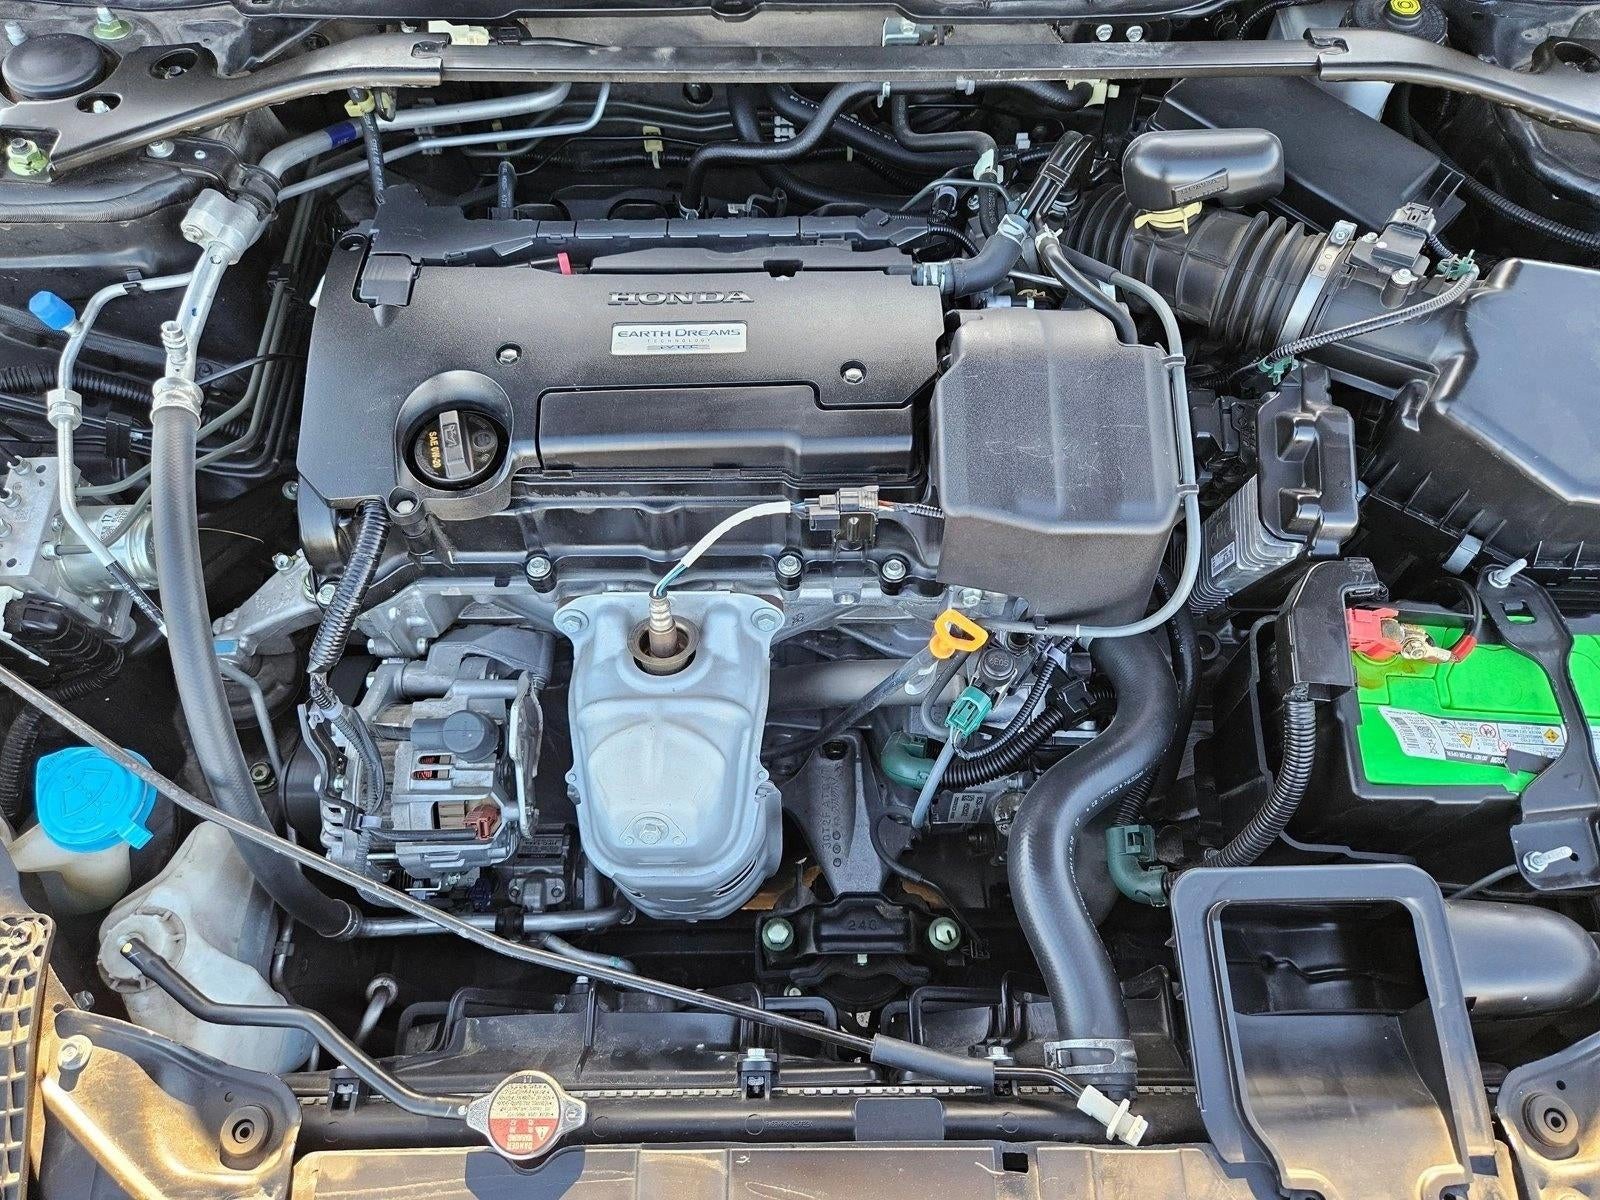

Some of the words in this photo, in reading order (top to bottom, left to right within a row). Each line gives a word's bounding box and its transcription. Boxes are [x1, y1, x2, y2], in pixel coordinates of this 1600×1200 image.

[608, 290, 755, 306] HONDA
[617, 329, 671, 338] EARTH
[674, 328, 741, 337] DREAMS
[428, 431, 439, 446] SAE
[430, 446, 442, 469] 0W-20
